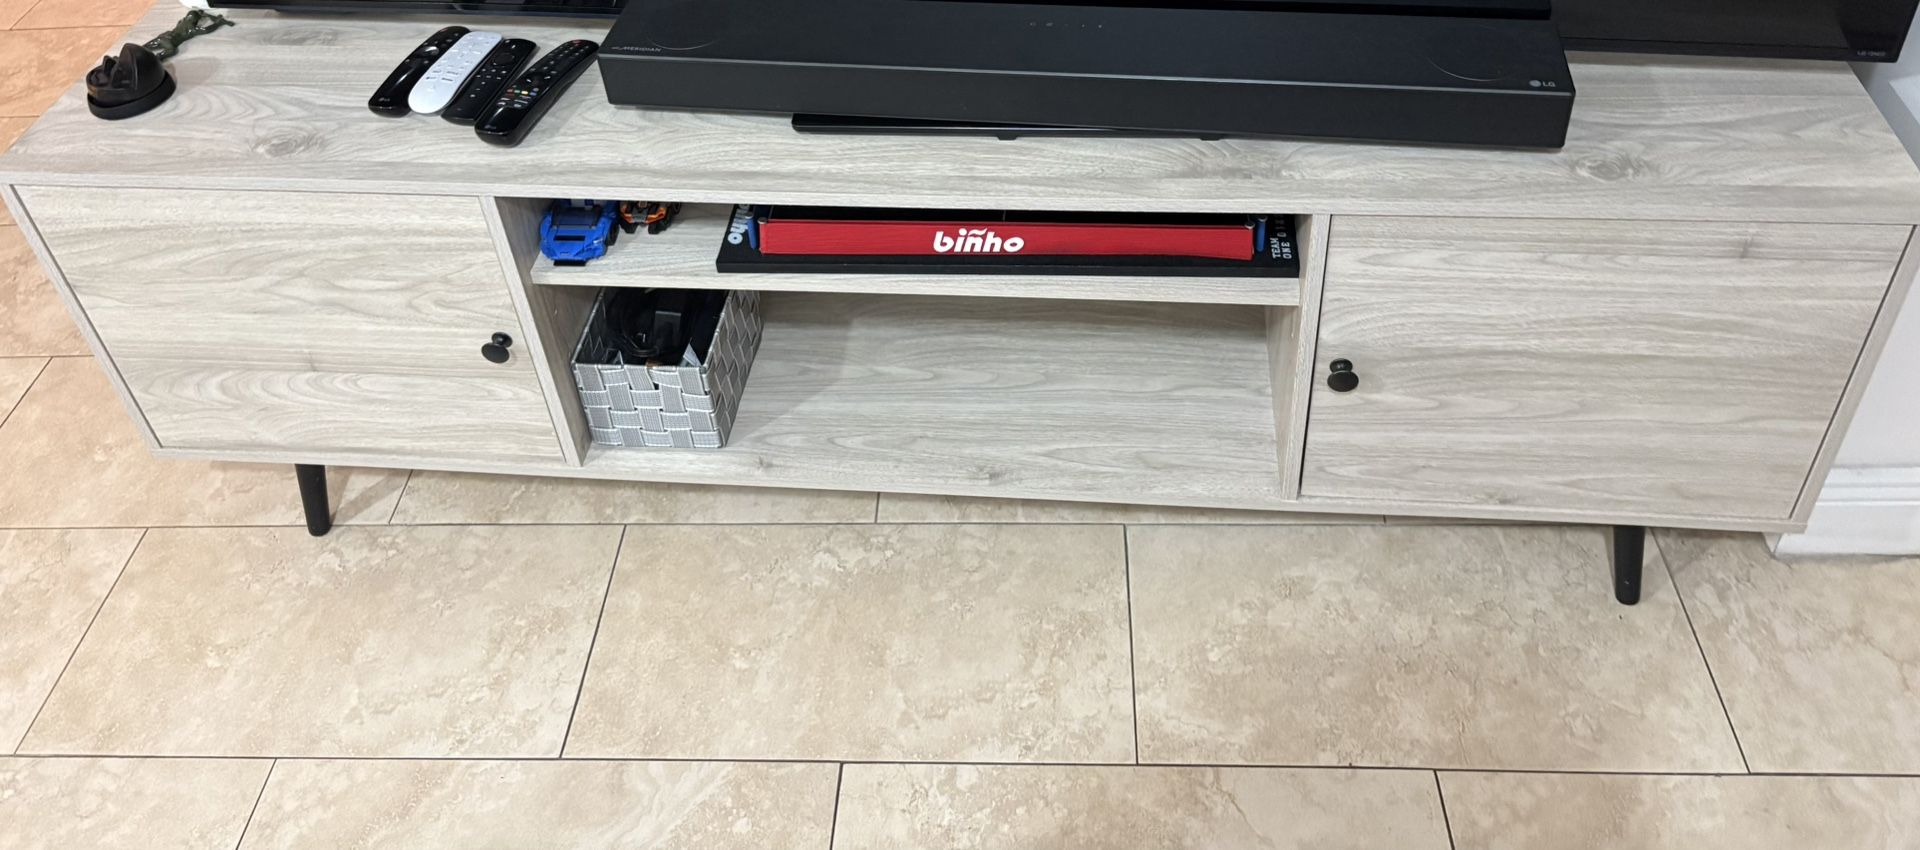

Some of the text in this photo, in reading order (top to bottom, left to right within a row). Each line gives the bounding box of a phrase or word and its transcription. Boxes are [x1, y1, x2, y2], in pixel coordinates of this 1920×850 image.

[933, 227, 1025, 252] biñho
[1269, 237, 1281, 259] TEAM
[1281, 241, 1292, 260] ONE
